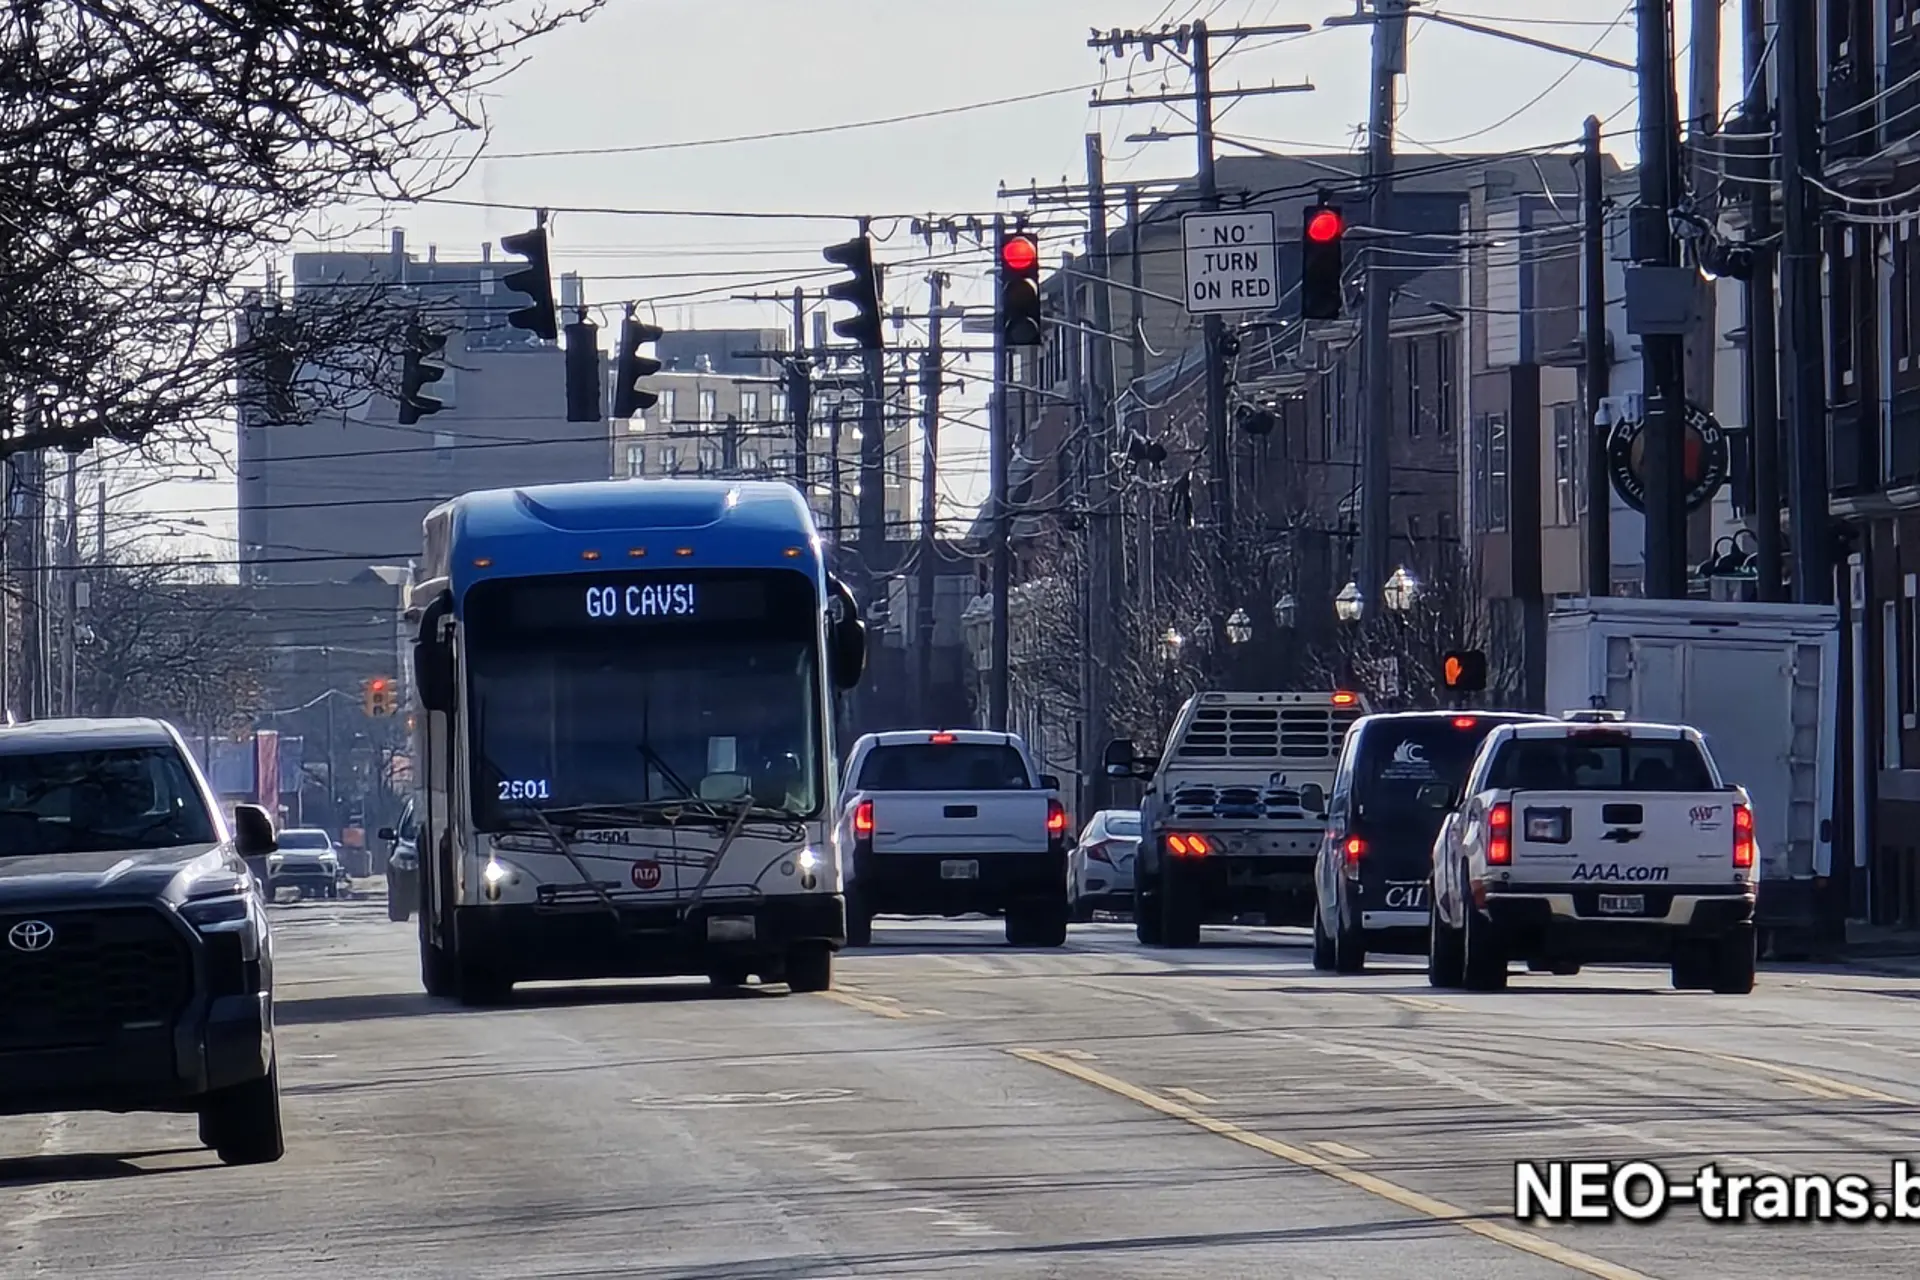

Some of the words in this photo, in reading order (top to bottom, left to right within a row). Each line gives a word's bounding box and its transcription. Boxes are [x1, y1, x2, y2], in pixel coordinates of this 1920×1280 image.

[1213, 225, 1245, 244] NO
[1203, 252, 1258, 272] TURN
[1194, 281, 1221, 300] ON
[1231, 278, 1270, 298] RED
[586, 586, 617, 617] GO
[625, 584, 694, 615] CAVS!
[1572, 863, 1669, 881] AAA.com
